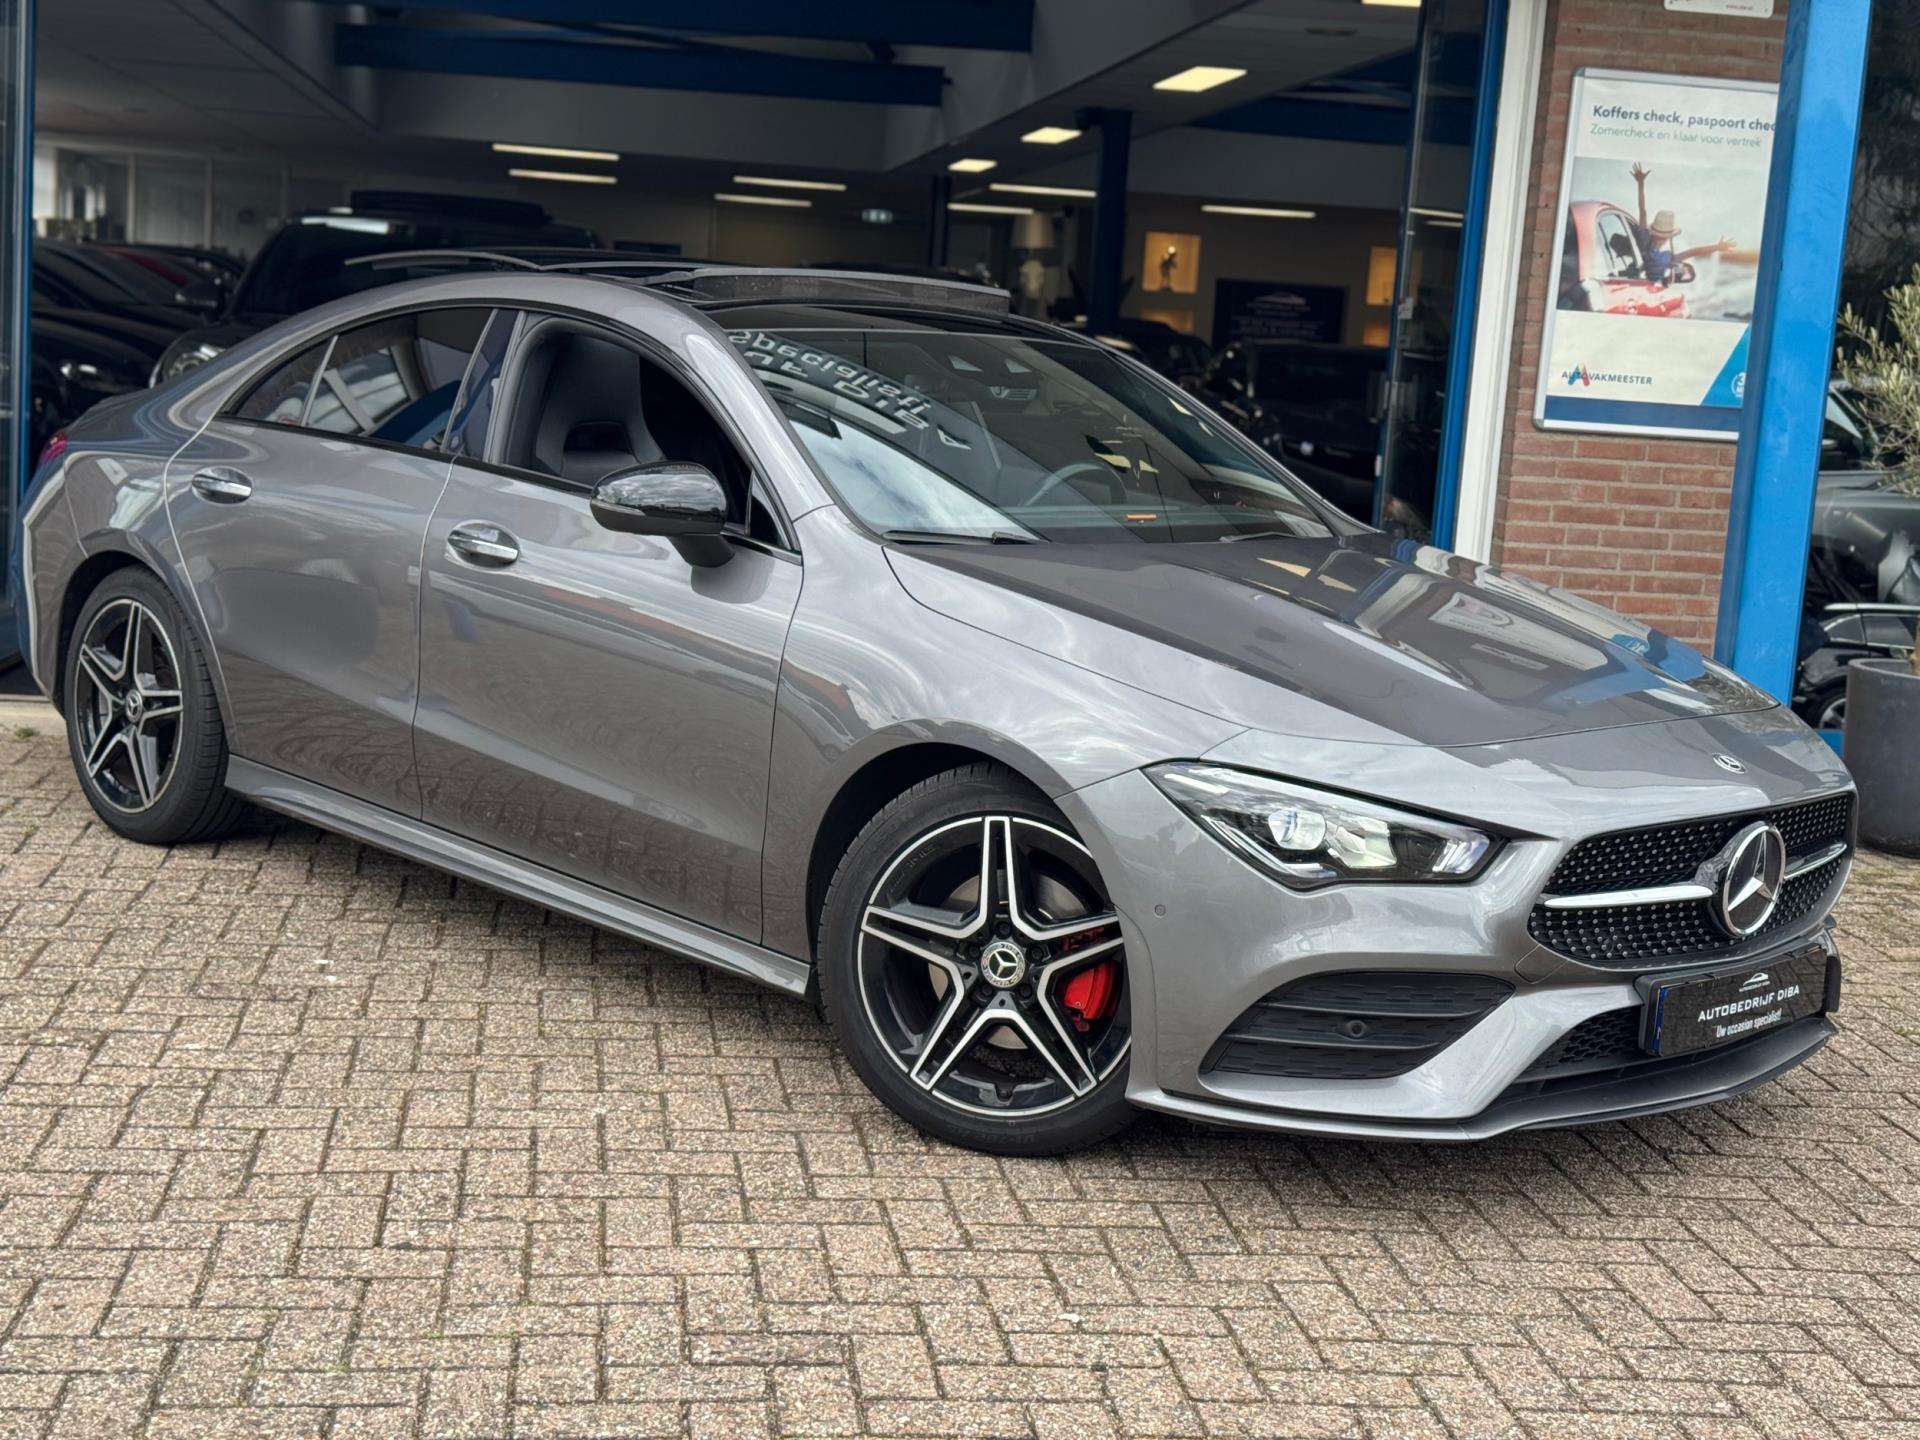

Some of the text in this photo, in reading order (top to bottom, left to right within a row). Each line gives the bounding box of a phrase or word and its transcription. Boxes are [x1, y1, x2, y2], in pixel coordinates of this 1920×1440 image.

[1593, 105, 1640, 121] Koffers
[1643, 110, 1684, 126] check,
[1687, 115, 1746, 130] paspoort
[1590, 123, 1761, 148] Zomercheck en klaar voor vertrek
[1697, 992, 1775, 1022] AUTOBEDRIJF
[1777, 984, 1800, 1000] DIBA
[1716, 1008, 1782, 1038] Uw occasion specialist!
